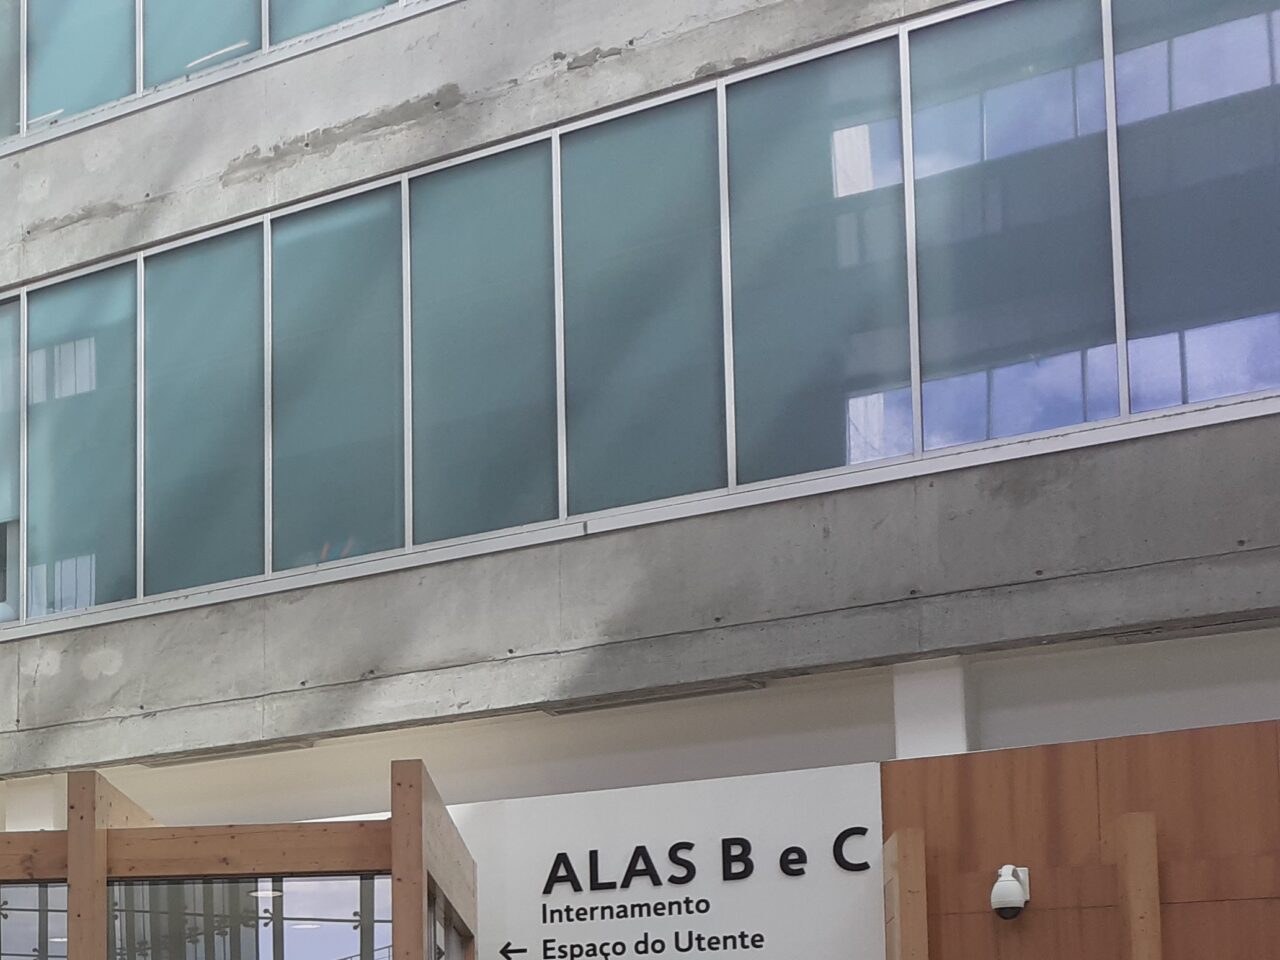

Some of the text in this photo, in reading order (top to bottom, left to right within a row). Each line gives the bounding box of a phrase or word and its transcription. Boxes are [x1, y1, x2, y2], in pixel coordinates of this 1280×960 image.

[542, 826, 871, 895] ALAS B e C
[541, 896, 711, 924] Internamento
[634, 933, 666, 955] do
[674, 929, 765, 953] Utente
